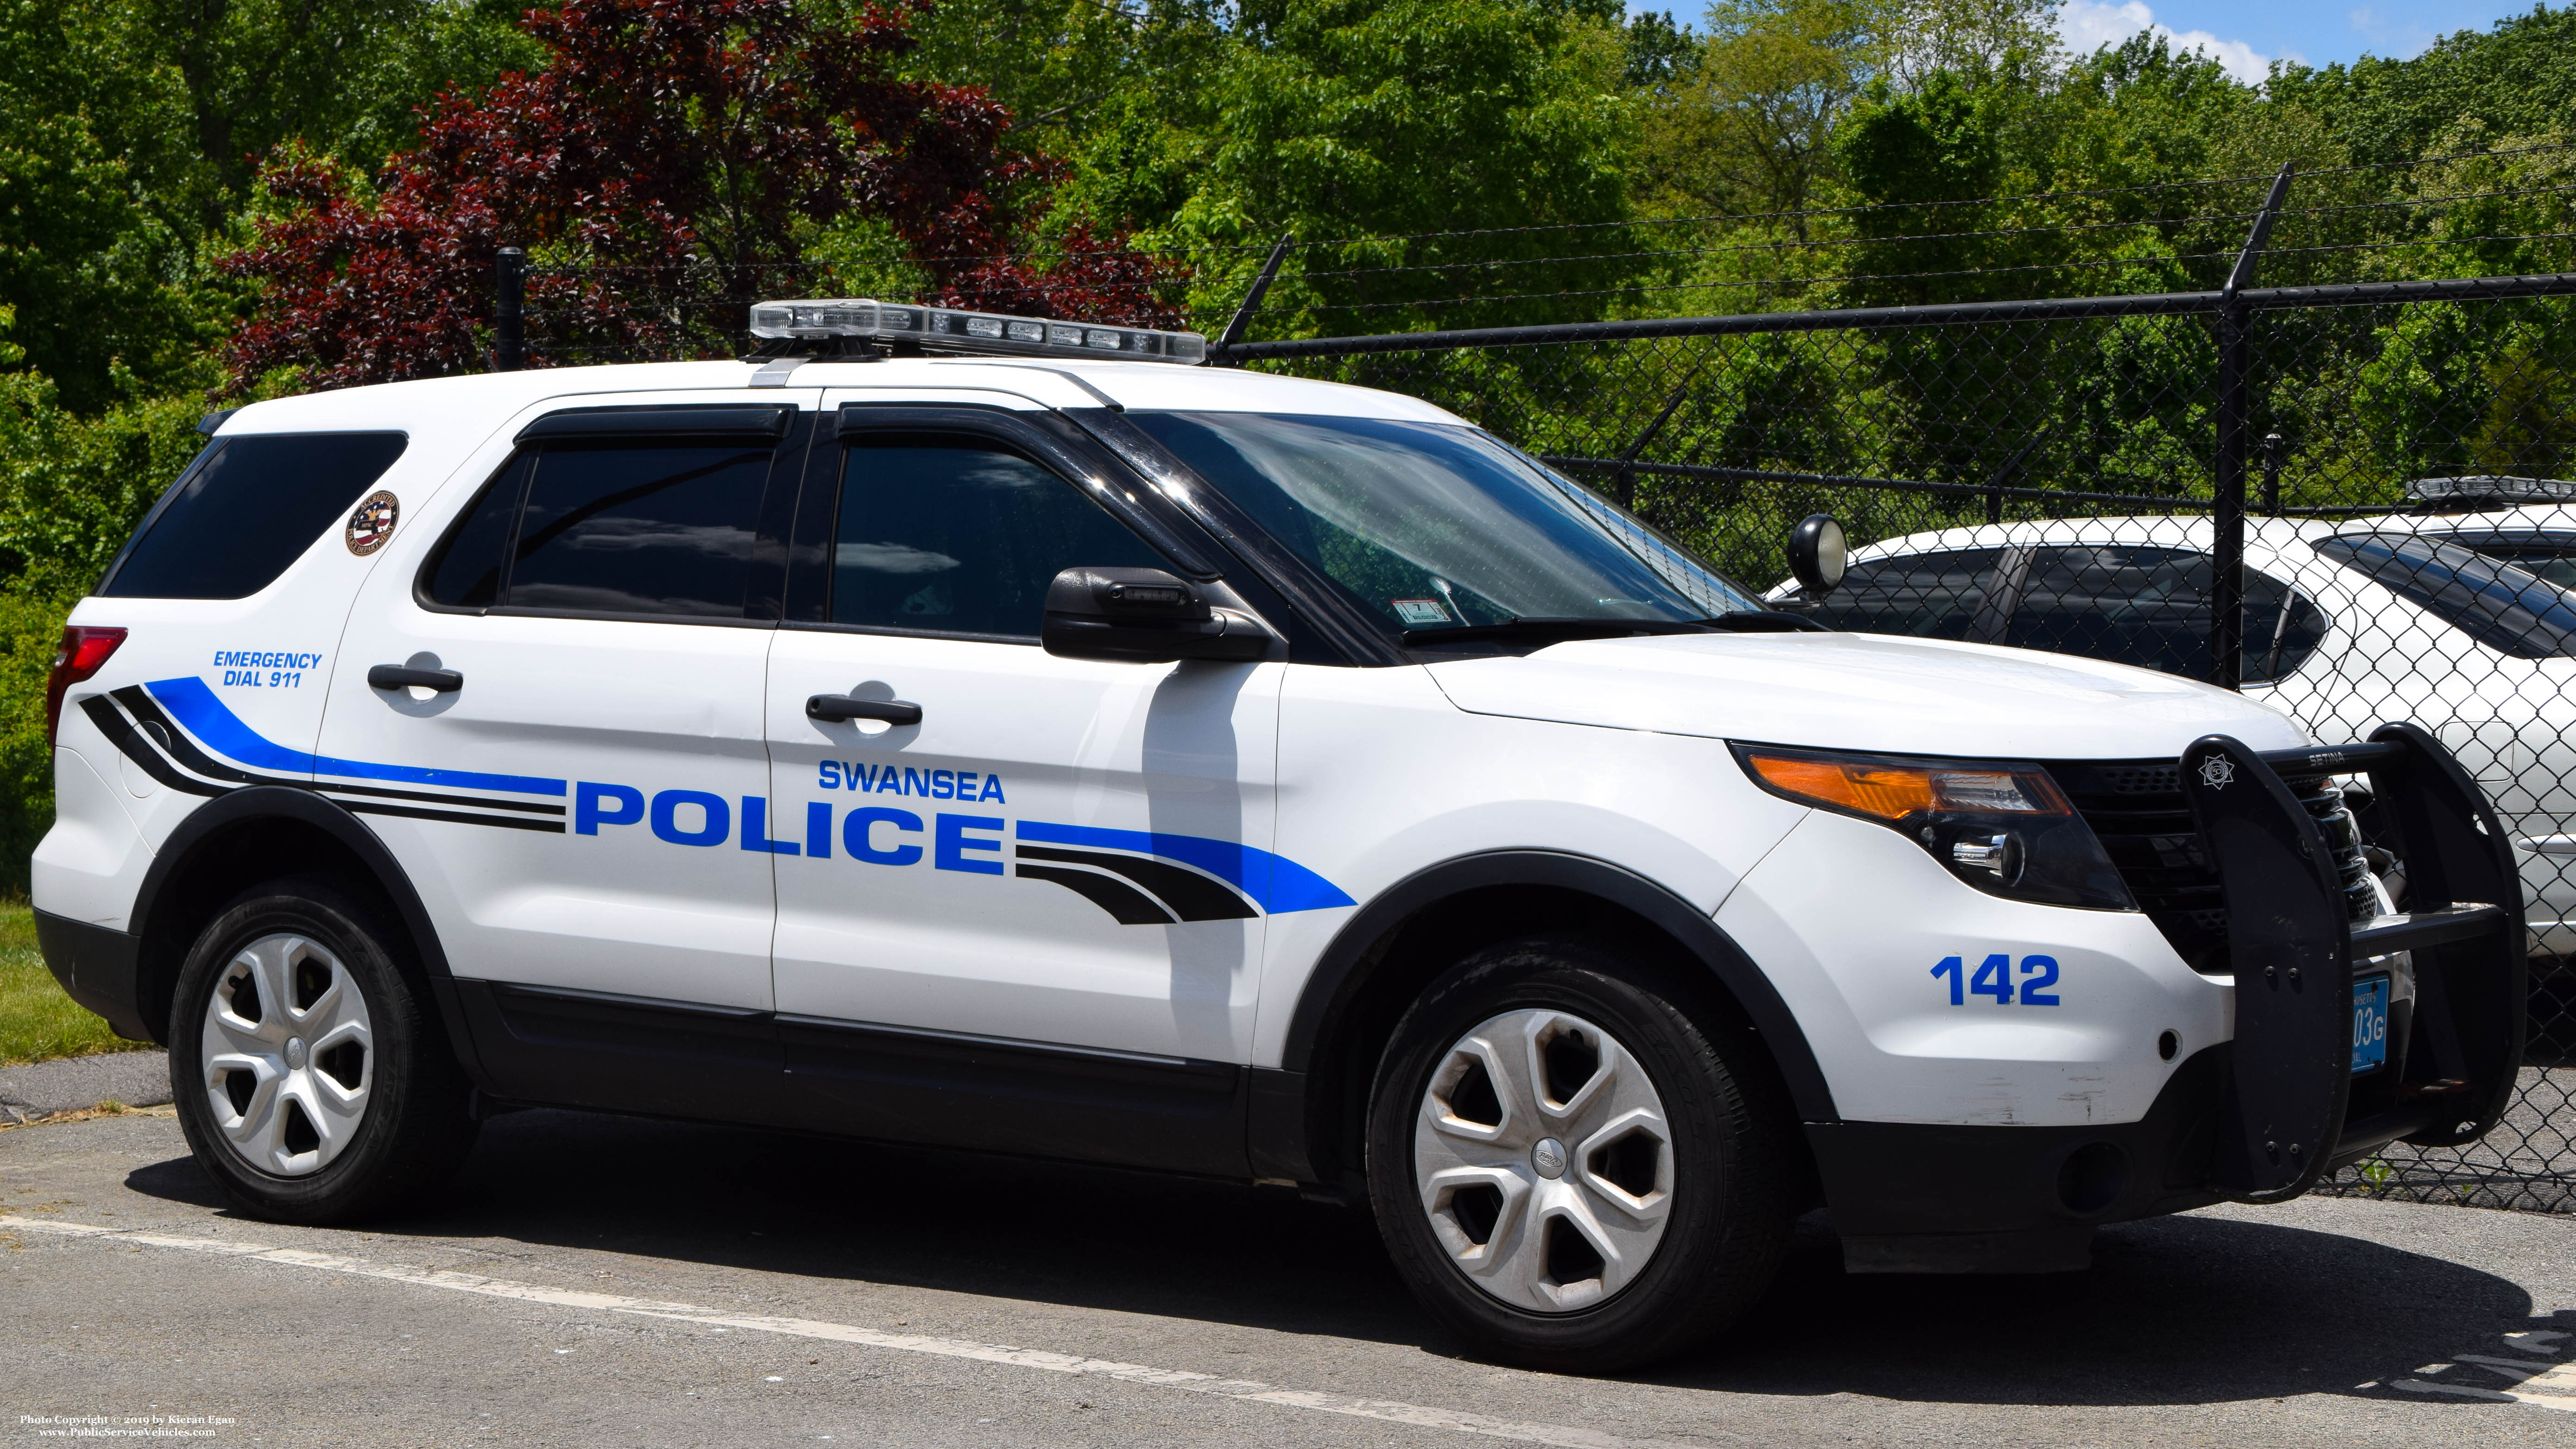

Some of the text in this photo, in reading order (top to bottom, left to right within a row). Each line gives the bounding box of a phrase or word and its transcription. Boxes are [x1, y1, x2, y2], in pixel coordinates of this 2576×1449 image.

[361, 494, 396, 510] ACCREDITED
[347, 524, 394, 553] POLICE DEPARTMENT
[213, 651, 322, 669] EMERGENCY
[223, 671, 301, 688] DIAL 911
[2309, 751, 2345, 766] SETINA
[819, 760, 1006, 804] SWANSEA
[575, 781, 1005, 876] POLICE
[1930, 954, 2060, 1006] 142
[1538, 1152, 1559, 1165] Ford
